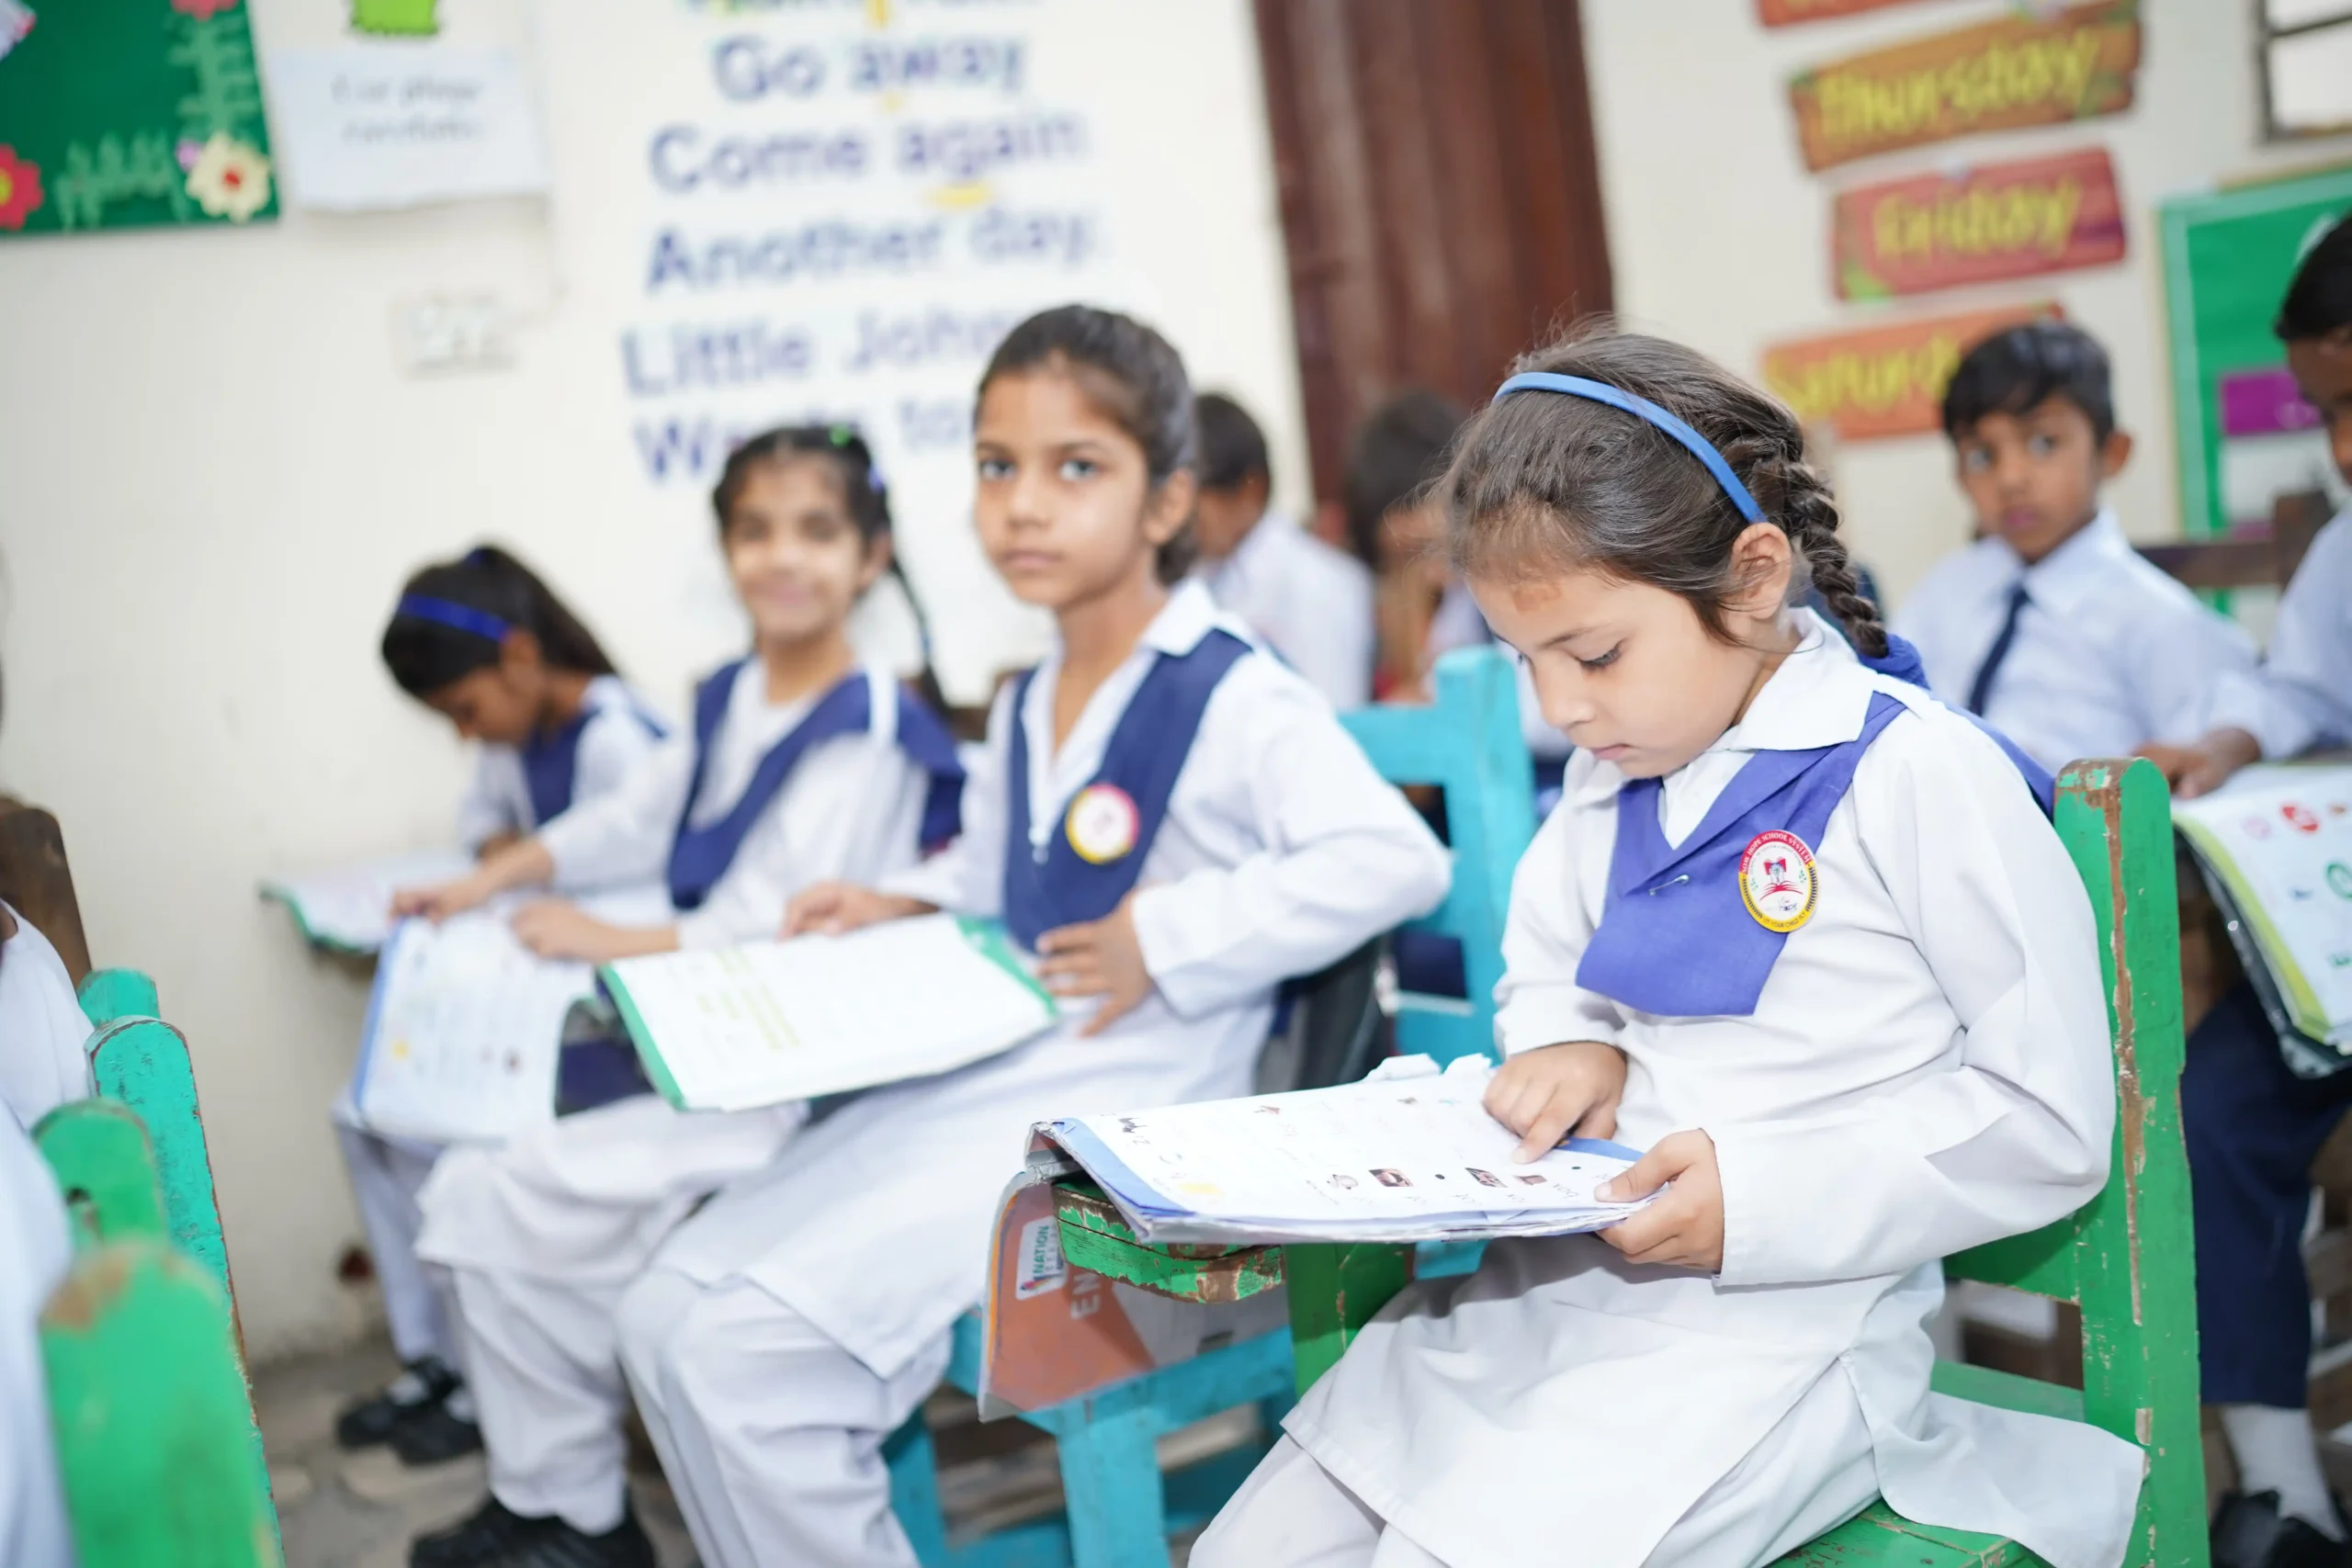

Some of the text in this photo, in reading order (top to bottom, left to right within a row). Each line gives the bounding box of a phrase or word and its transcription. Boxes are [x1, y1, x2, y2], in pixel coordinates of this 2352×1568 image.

[713, 36, 1024, 100] Go away
[649, 112, 1088, 192] Come again
[646, 217, 943, 292] Another
[620, 306, 1016, 397] Little John
[1747, 838, 1762, 856] HOPE
[1761, 832, 1788, 841] SCHOOL
[1788, 838, 1812, 863] SYSTEM
[1032, 1225, 1050, 1274] NATION
[1070, 1272, 1101, 1320] EN
